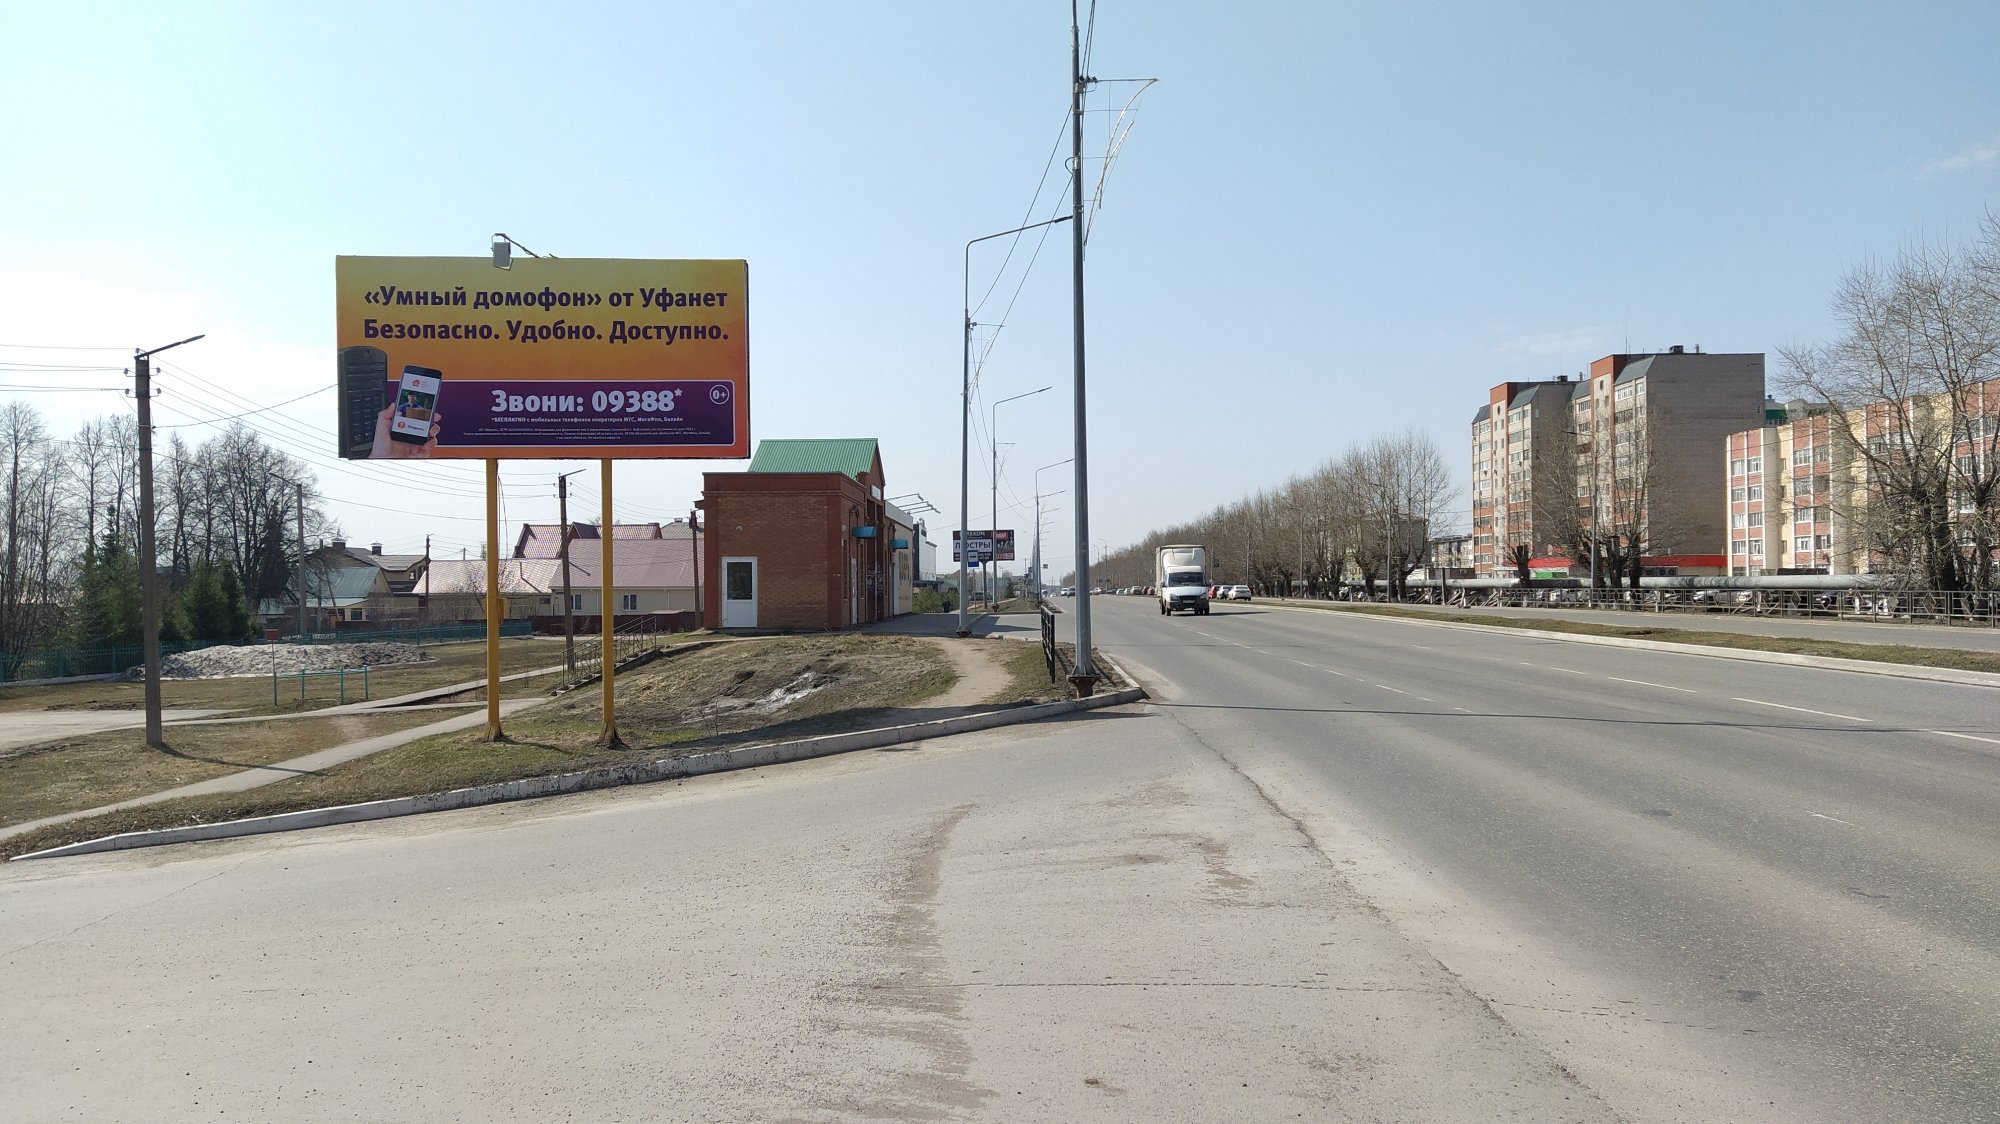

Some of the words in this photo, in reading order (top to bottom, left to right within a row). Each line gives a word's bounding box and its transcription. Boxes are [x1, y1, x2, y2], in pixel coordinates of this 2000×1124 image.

[364, 285, 466, 306] «Умный
[473, 287, 602, 312] домофон»
[608, 292, 634, 307] от
[639, 288, 728, 312] Уфанет
[364, 319, 500, 340] Безопасно.
[506, 319, 603, 344] Удобно.
[609, 320, 729, 346] Доступно.
[491, 389, 584, 413] Звони:
[712, 389, 727, 400] 0+
